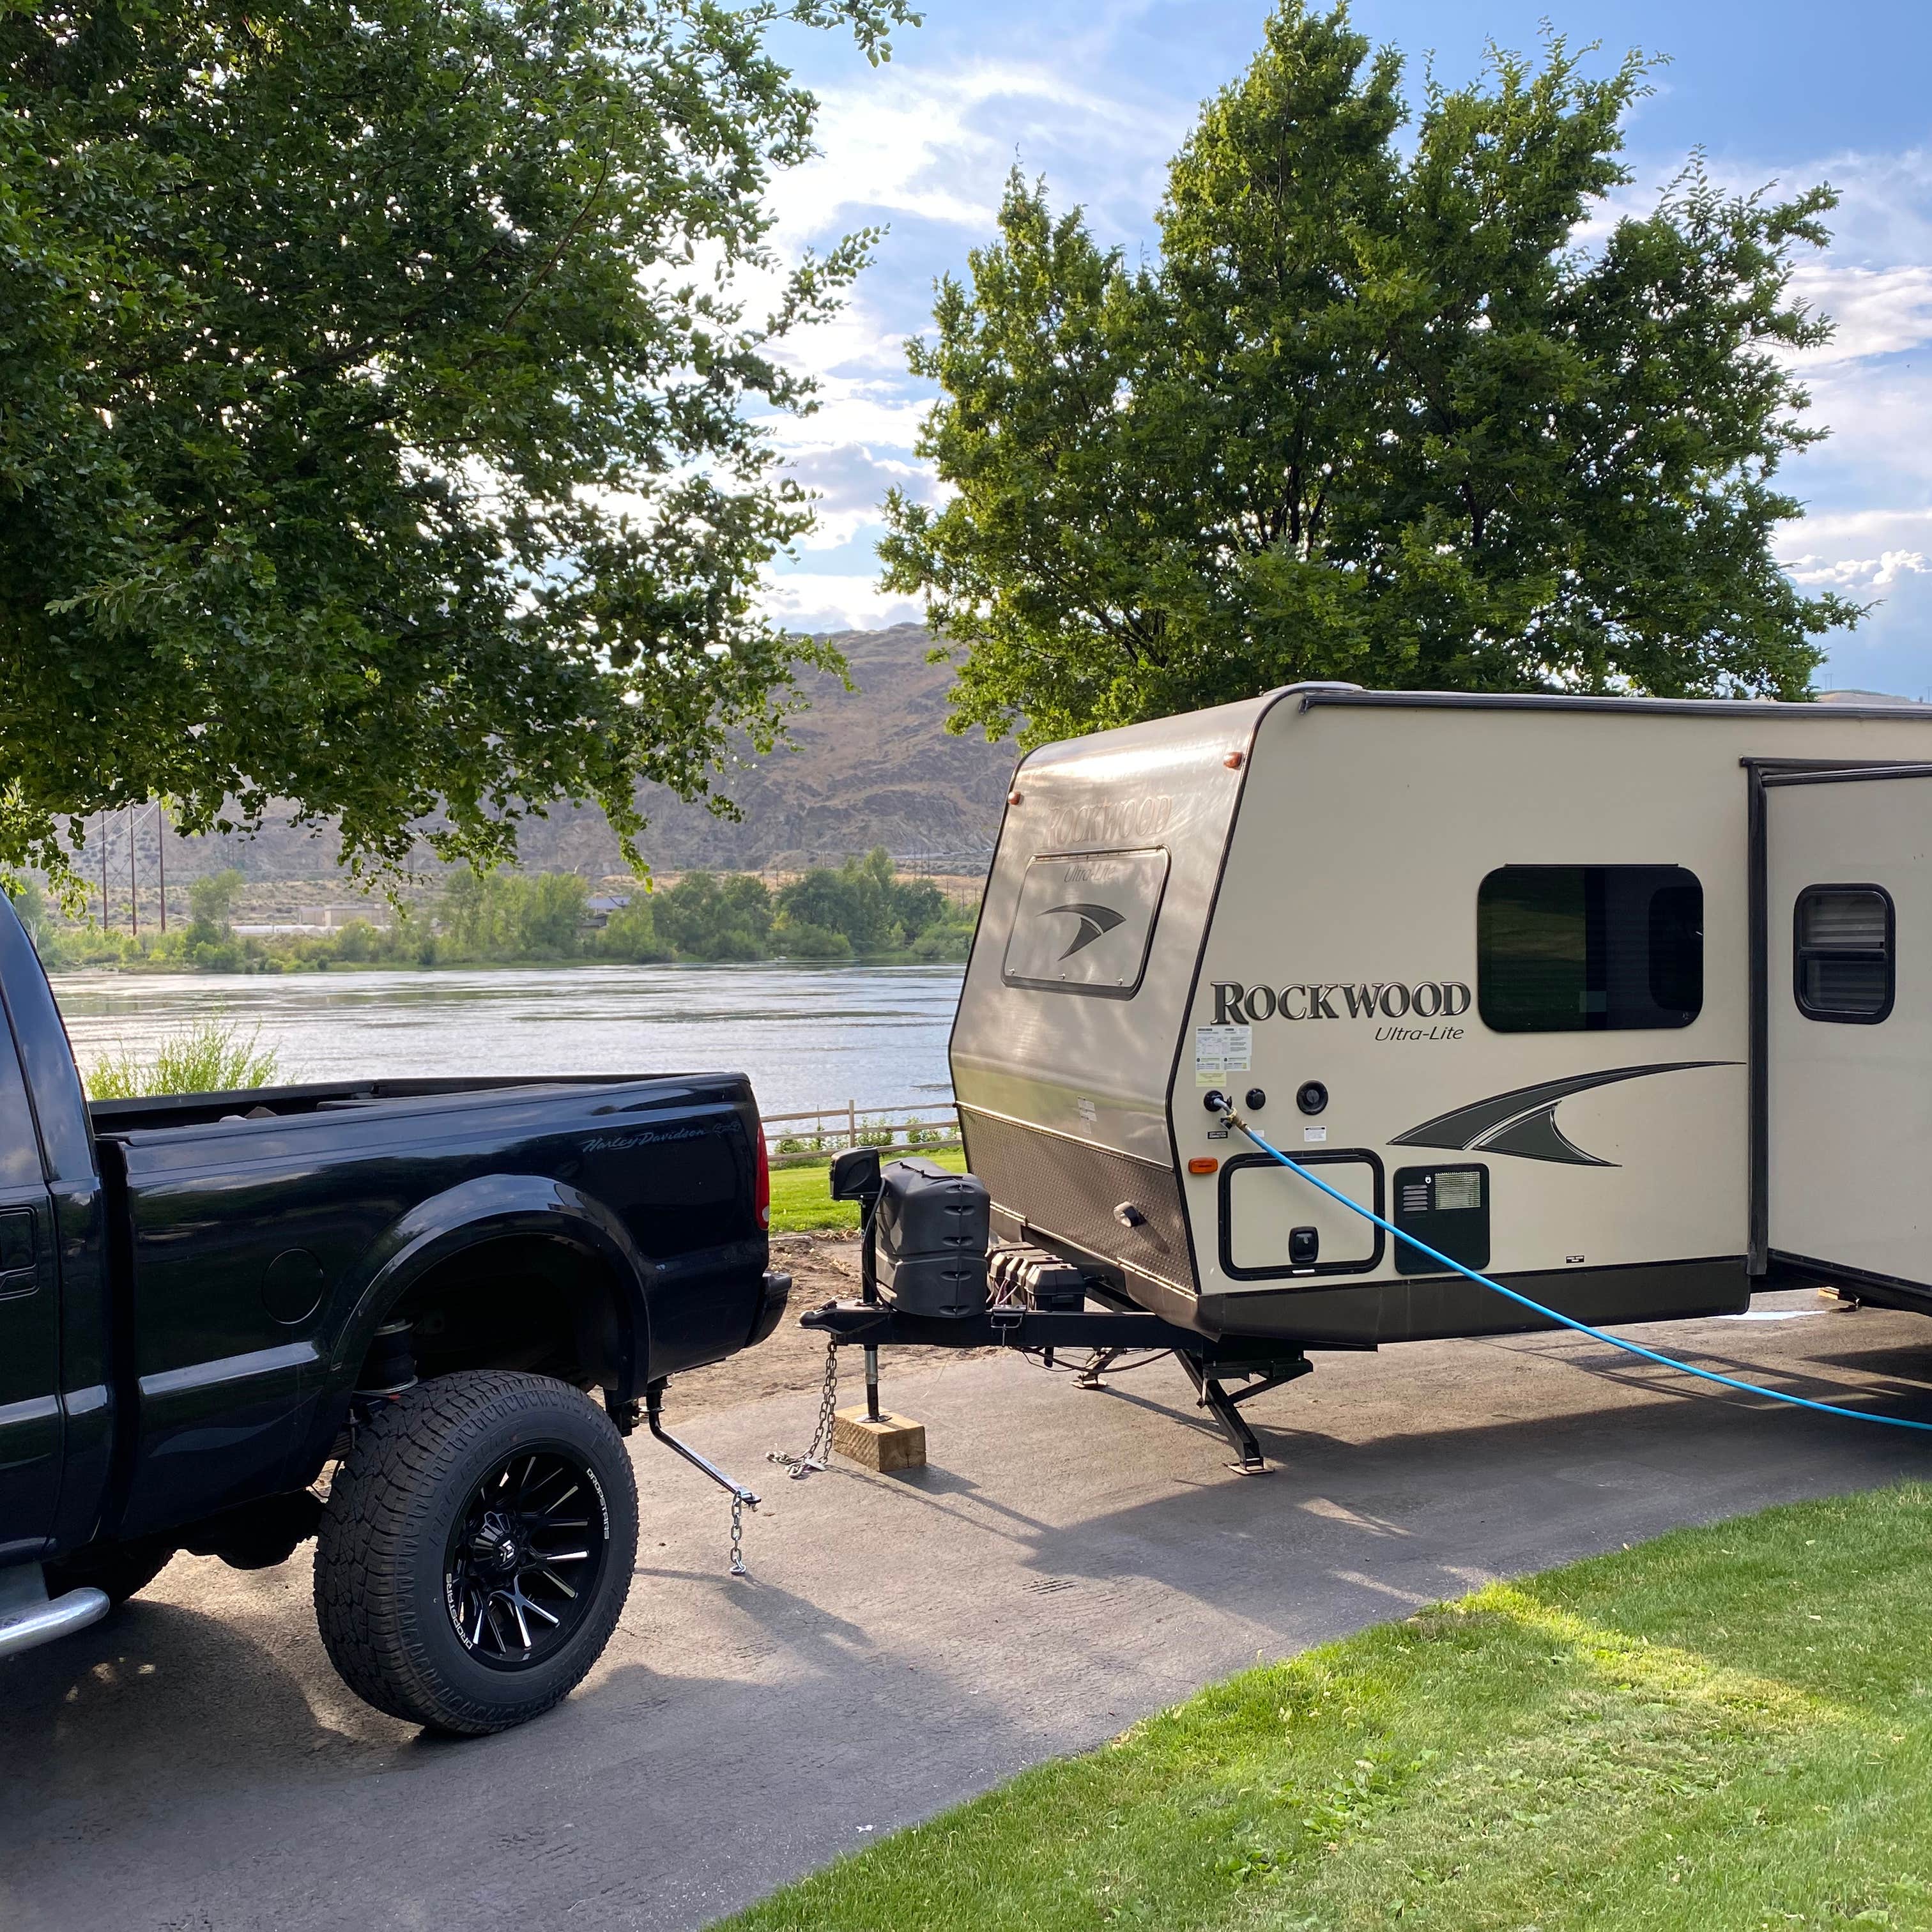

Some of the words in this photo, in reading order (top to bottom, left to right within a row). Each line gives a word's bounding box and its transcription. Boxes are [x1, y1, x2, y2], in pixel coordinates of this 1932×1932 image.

[1042, 797, 1172, 849] ROCKWOOD
[1064, 864, 1116, 883] Ultra-Lite
[1210, 981, 1471, 1025] ROCKWOOD
[1375, 1026, 1464, 1041] Ultra-Lite
[586, 1468, 610, 1540] DROPSTARS
[446, 1573, 473, 1650] DROPSTARS
